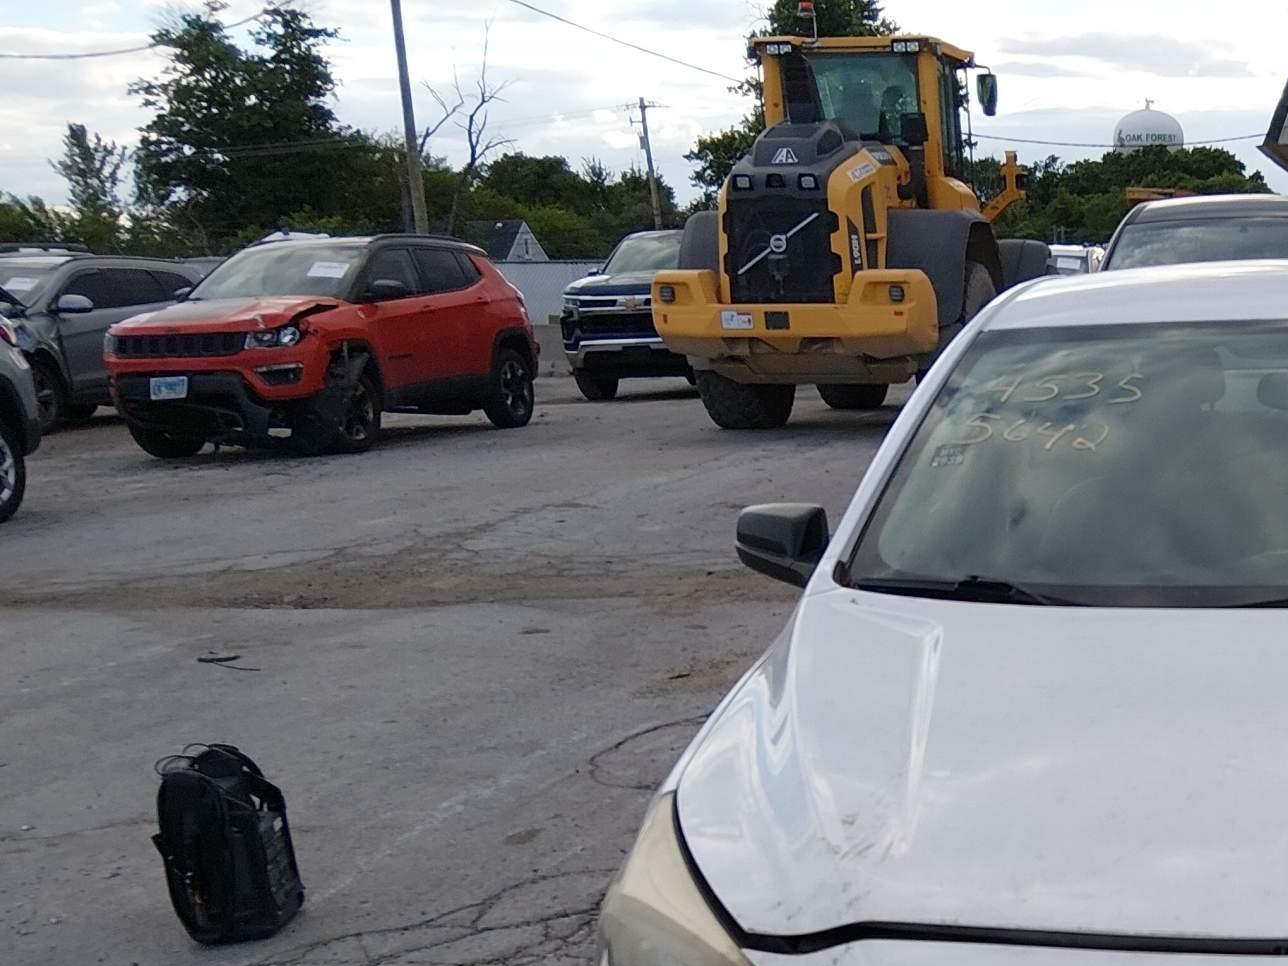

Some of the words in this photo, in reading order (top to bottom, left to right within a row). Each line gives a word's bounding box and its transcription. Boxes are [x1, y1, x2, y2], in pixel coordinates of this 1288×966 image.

[1125, 133, 1143, 143] OAK
[1145, 133, 1177, 143] FOREST
[988, 372, 1145, 404] 4535
[950, 412, 1109, 451] 5642
